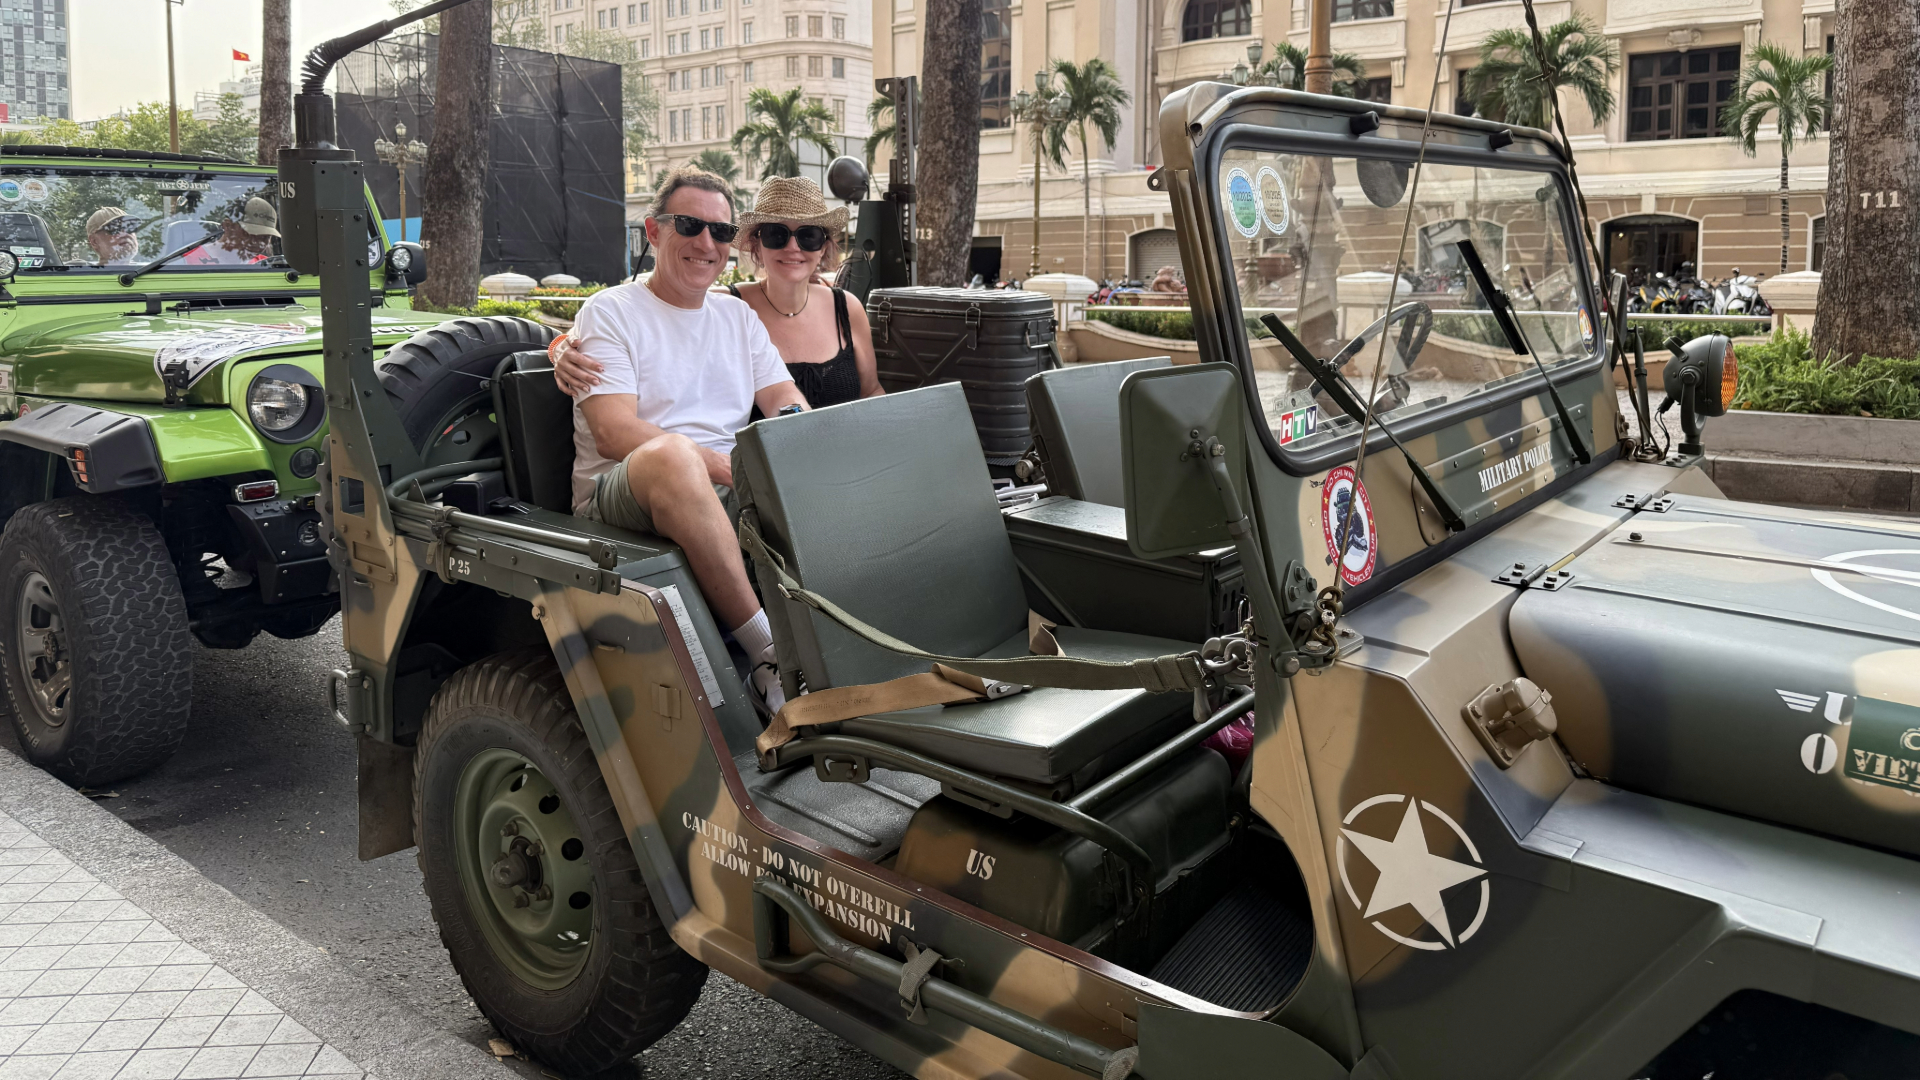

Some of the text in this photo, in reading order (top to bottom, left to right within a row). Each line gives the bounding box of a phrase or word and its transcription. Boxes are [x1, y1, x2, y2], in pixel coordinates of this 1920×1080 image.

[280, 181, 296, 199] US
[1860, 190, 1900, 209] T11
[17, 257, 44, 267] TV
[1281, 409, 1316, 441] HTV
[1326, 476, 1334, 493] HO
[1333, 468, 1343, 480] CHI
[1477, 441, 1554, 493] MILITARY POLICE
[1322, 509, 1330, 535] OFF
[1345, 563, 1371, 583] VEHICLES
[449, 556, 470, 576] P 25
[682, 811, 749, 855] CAUTION
[762, 846, 784, 870] DO
[788, 857, 822, 889] NOT
[826, 876, 915, 931] OVERFILL
[966, 848, 997, 880] US
[701, 841, 751, 877] ALLOW
[793, 882, 892, 944] EXPANSION
